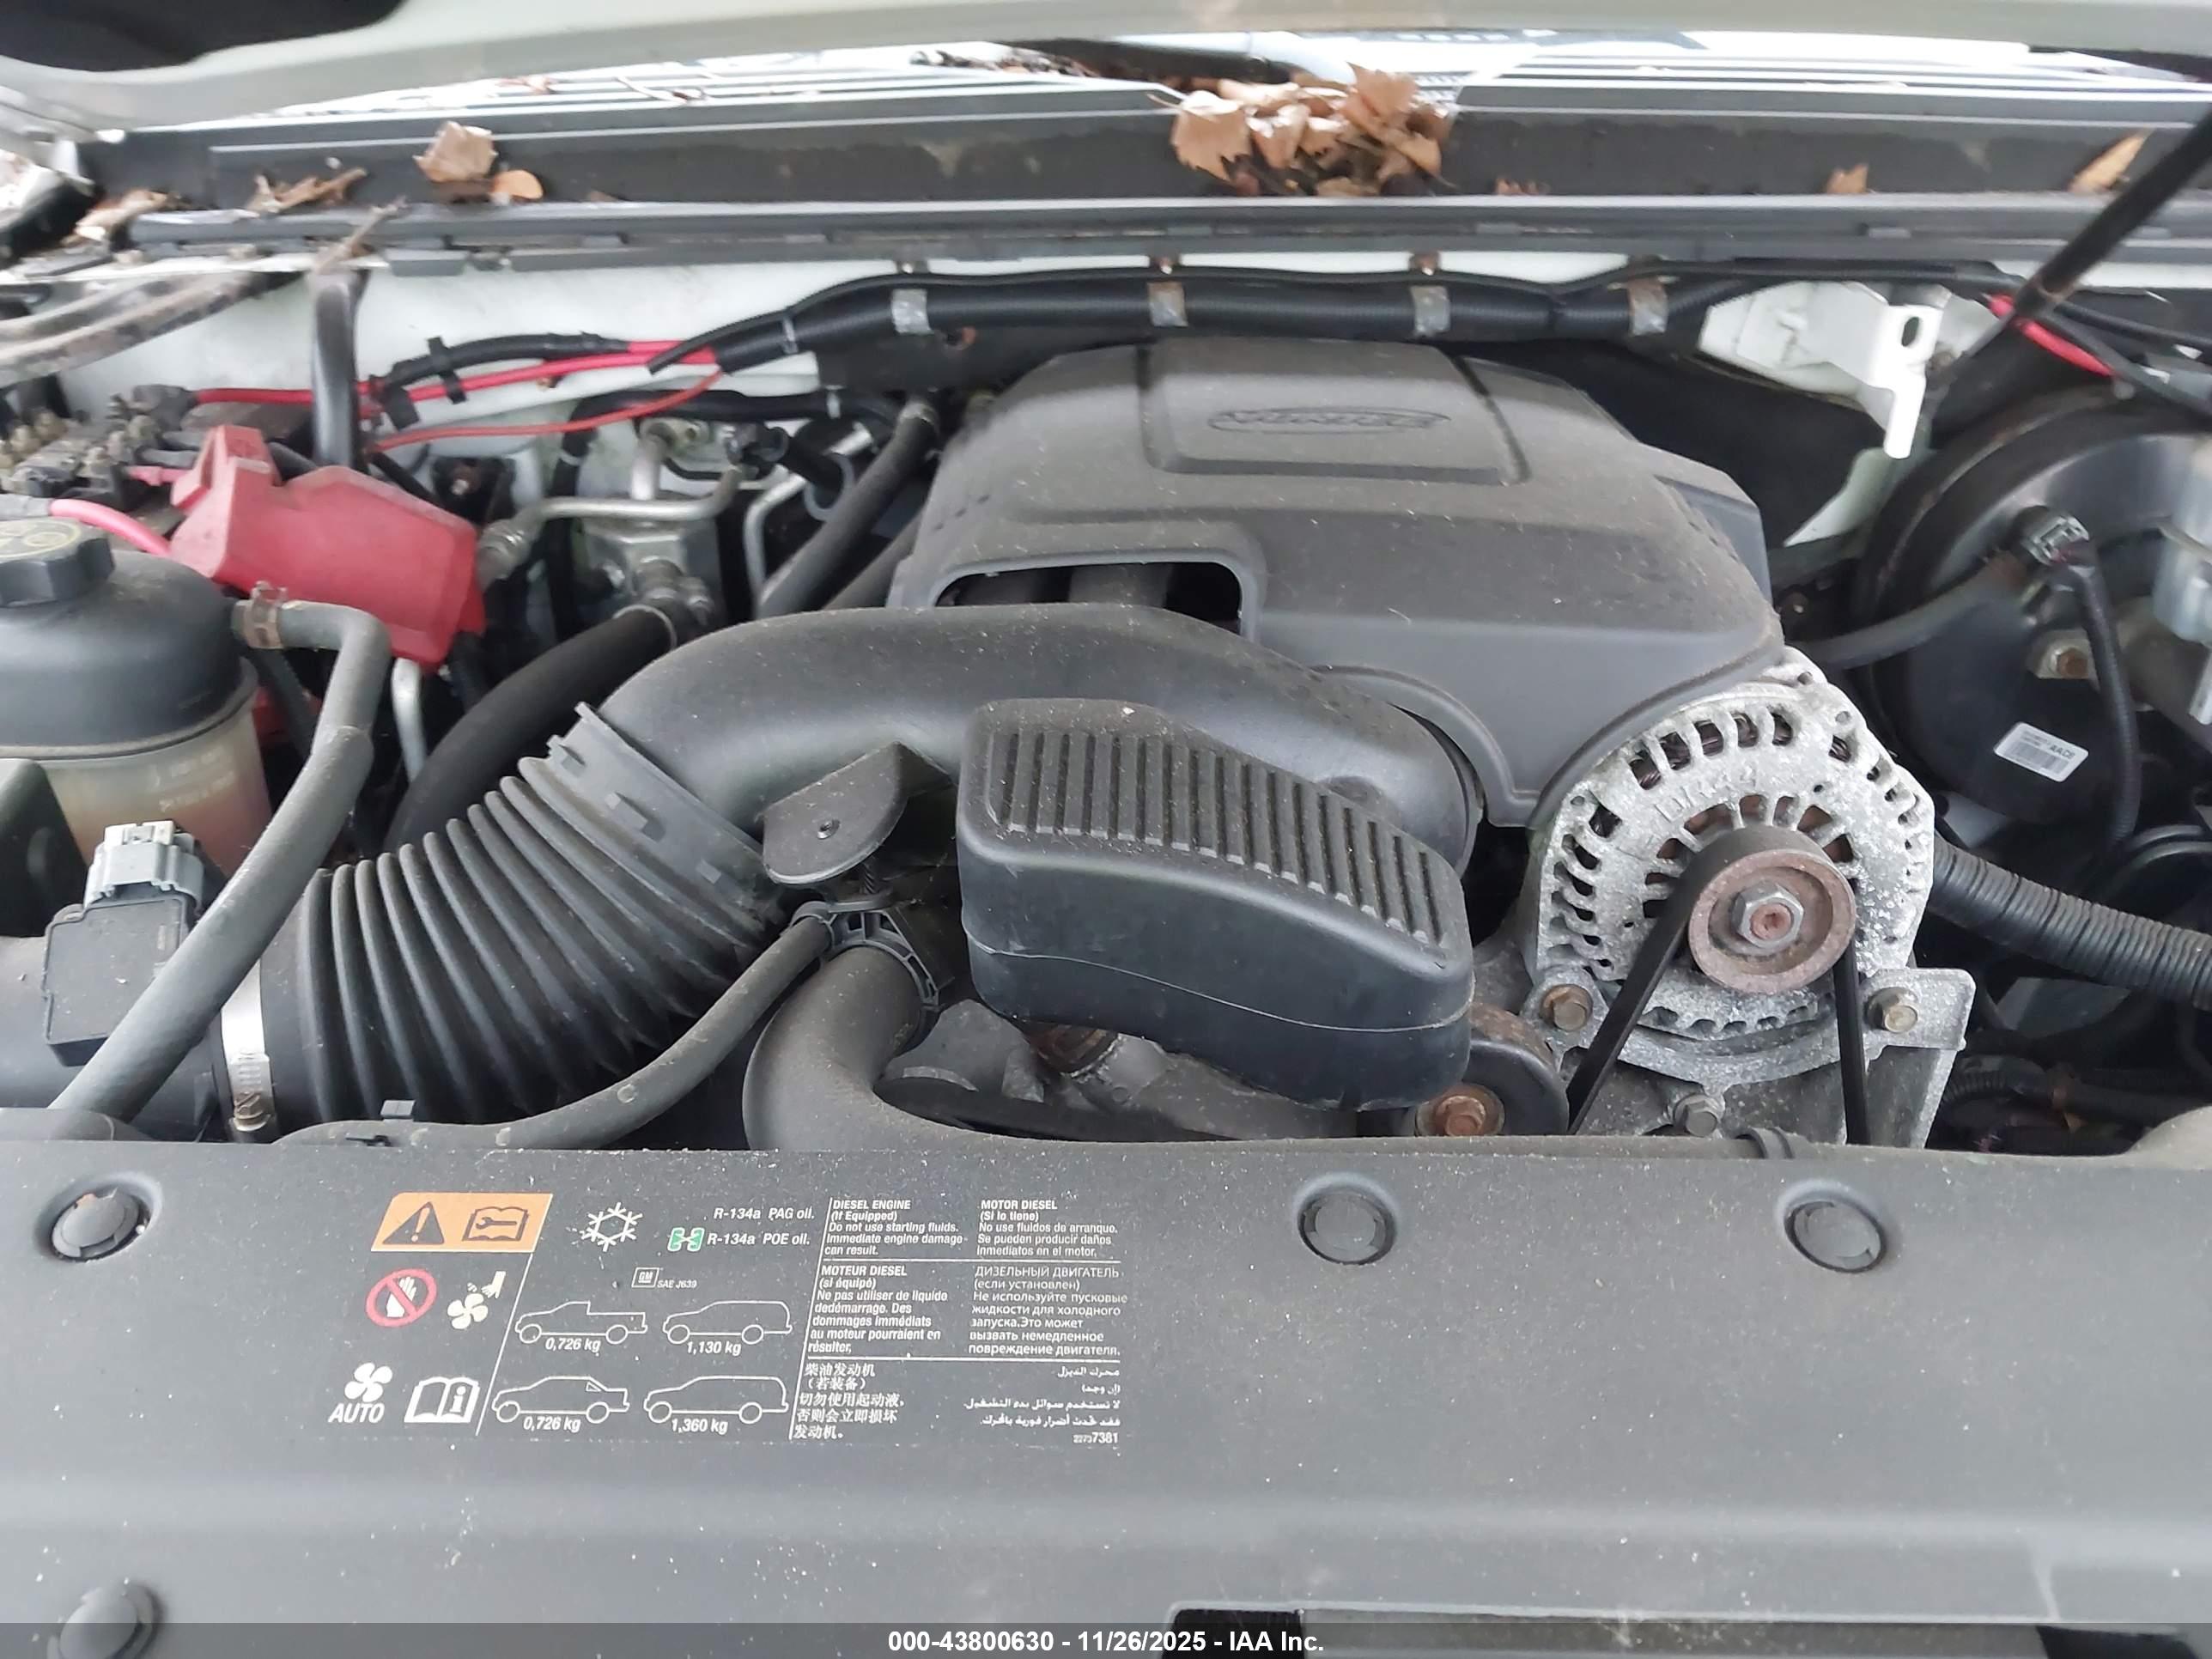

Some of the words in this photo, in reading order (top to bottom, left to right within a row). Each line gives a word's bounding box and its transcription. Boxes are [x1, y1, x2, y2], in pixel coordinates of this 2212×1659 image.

[833, 1200, 869, 1210] DIESEL
[872, 1200, 911, 1210] ENGINE
[981, 1200, 1018, 1210] MOTOR
[1022, 1200, 1057, 1210] DIESEL
[714, 1208, 761, 1219] R-134a
[769, 1208, 793, 1219] PAG
[797, 1206, 815, 1219] oil.
[831, 1211, 843, 1222] (If
[845, 1211, 897, 1222] Equipped)
[981, 1211, 994, 1222] (Si
[997, 1212, 1007, 1221] lo
[1010, 1211, 1039, 1222] tiene)
[830, 1223, 842, 1232] Do
[846, 1223, 862, 1232] not
[886, 1223, 925, 1234] starting
[928, 1223, 959, 1232] fluids.
[979, 1223, 994, 1232] No
[1017, 1223, 1050, 1232] fluidos
[1054, 1223, 1066, 1232] de
[1070, 1224, 1118, 1234] arranque.
[707, 1234, 756, 1245] R-134a
[763, 1234, 788, 1245] POE
[791, 1233, 810, 1245] oil.
[827, 1233, 881, 1243] Immediate
[884, 1234, 919, 1245] engine
[921, 1234, 963, 1245] damage
[978, 1234, 991, 1243] Se
[994, 1234, 1032, 1245] pueden
[1035, 1234, 1078, 1245] producir
[1081, 1234, 1112, 1244] daños
[847, 1245, 878, 1255] result.
[1036, 1248, 1049, 1256] en
[1053, 1246, 1062, 1256] el
[821, 1266, 866, 1276] MOTEUR
[870, 1266, 907, 1276] DIESEL
[975, 1265, 1049, 1278] ДИЗЕЛЬНЫЙ
[1052, 1267, 1119, 1279] ДВИГАТЕЛЬ
[638, 1272, 653, 1283] GM
[819, 1278, 833, 1289] (si
[836, 1278, 877, 1289] équipé)
[974, 1279, 1006, 1291] (если
[1009, 1279, 1080, 1291] установлен)
[817, 1291, 831, 1301] Ne
[834, 1292, 854, 1302] pas
[857, 1291, 893, 1301] utiliser
[896, 1291, 909, 1301] de
[912, 1291, 948, 1303] liquide
[973, 1291, 989, 1301] Не
[992, 1291, 1066, 1304] используйте
[1072, 1293, 1127, 1304] пусковые
[815, 1303, 888, 1315] dedémarrage.
[891, 1303, 912, 1313] Des
[972, 1305, 1030, 1316] жидкости
[1032, 1305, 1054, 1316] для
[1058, 1306, 1121, 1317] холодного
[812, 1316, 872, 1328] dommages
[875, 1316, 932, 1327] immédiats
[1045, 1320, 1084, 1328] может
[811, 1330, 823, 1340] au
[827, 1329, 866, 1340] moteur
[868, 1329, 925, 1341] pourraient
[927, 1331, 941, 1340] en
[969, 1332, 1018, 1340] вызвать
[1022, 1332, 1104, 1343] немедленное
[544, 1337, 582, 1352] 0,726
[583, 1339, 601, 1353] kg
[686, 1340, 721, 1354] 1,130
[725, 1341, 742, 1357] kg
[969, 1344, 1053, 1356] повреждение
[1055, 1345, 1121, 1357] двигателя.
[804, 1363, 876, 1376] 柴油发动机
[328, 1403, 386, 1423] AUTO
[522, 1417, 561, 1431] 0,726
[563, 1418, 580, 1433] kg
[672, 1419, 708, 1433] 1,360
[711, 1419, 728, 1435] kg
